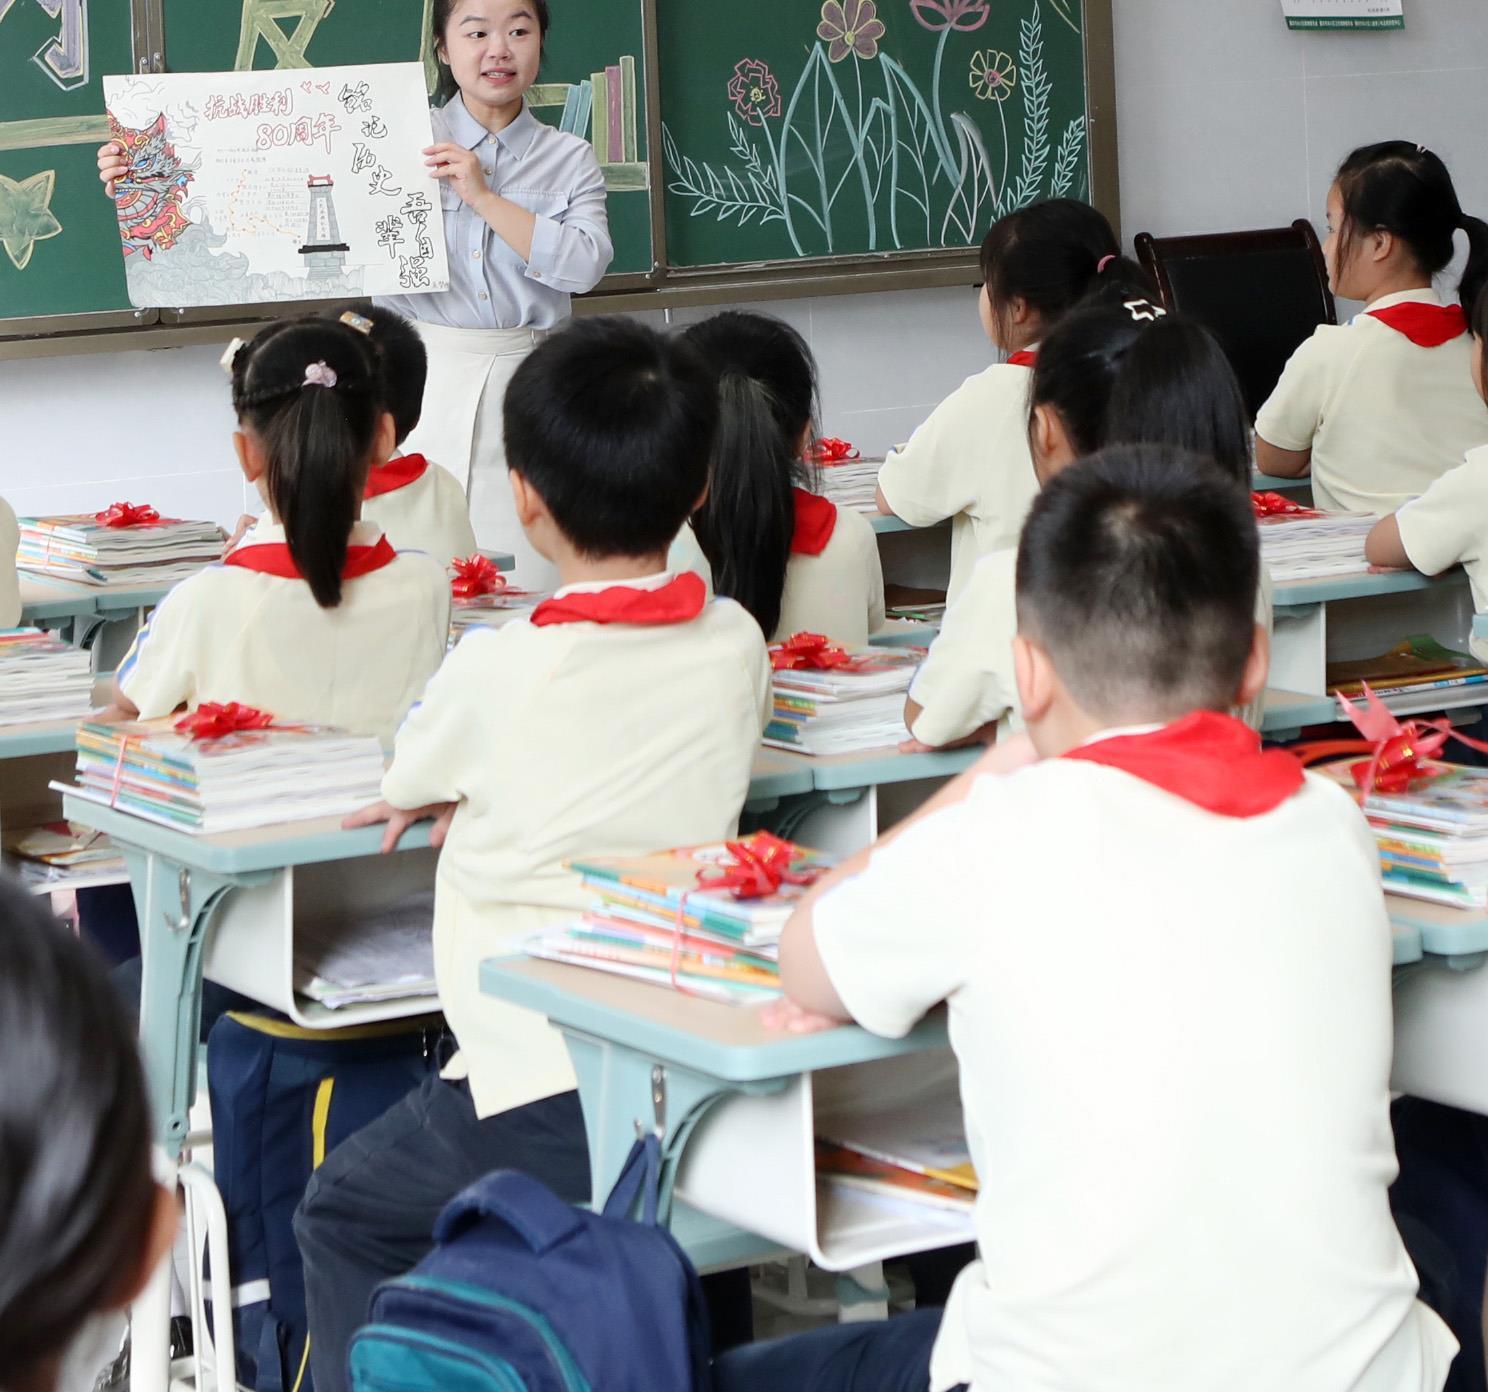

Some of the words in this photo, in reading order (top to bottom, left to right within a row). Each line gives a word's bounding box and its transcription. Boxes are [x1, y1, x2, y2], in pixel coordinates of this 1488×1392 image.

[204, 88, 294, 121] 抗战胜利
[256, 113, 342, 154] 80周年
